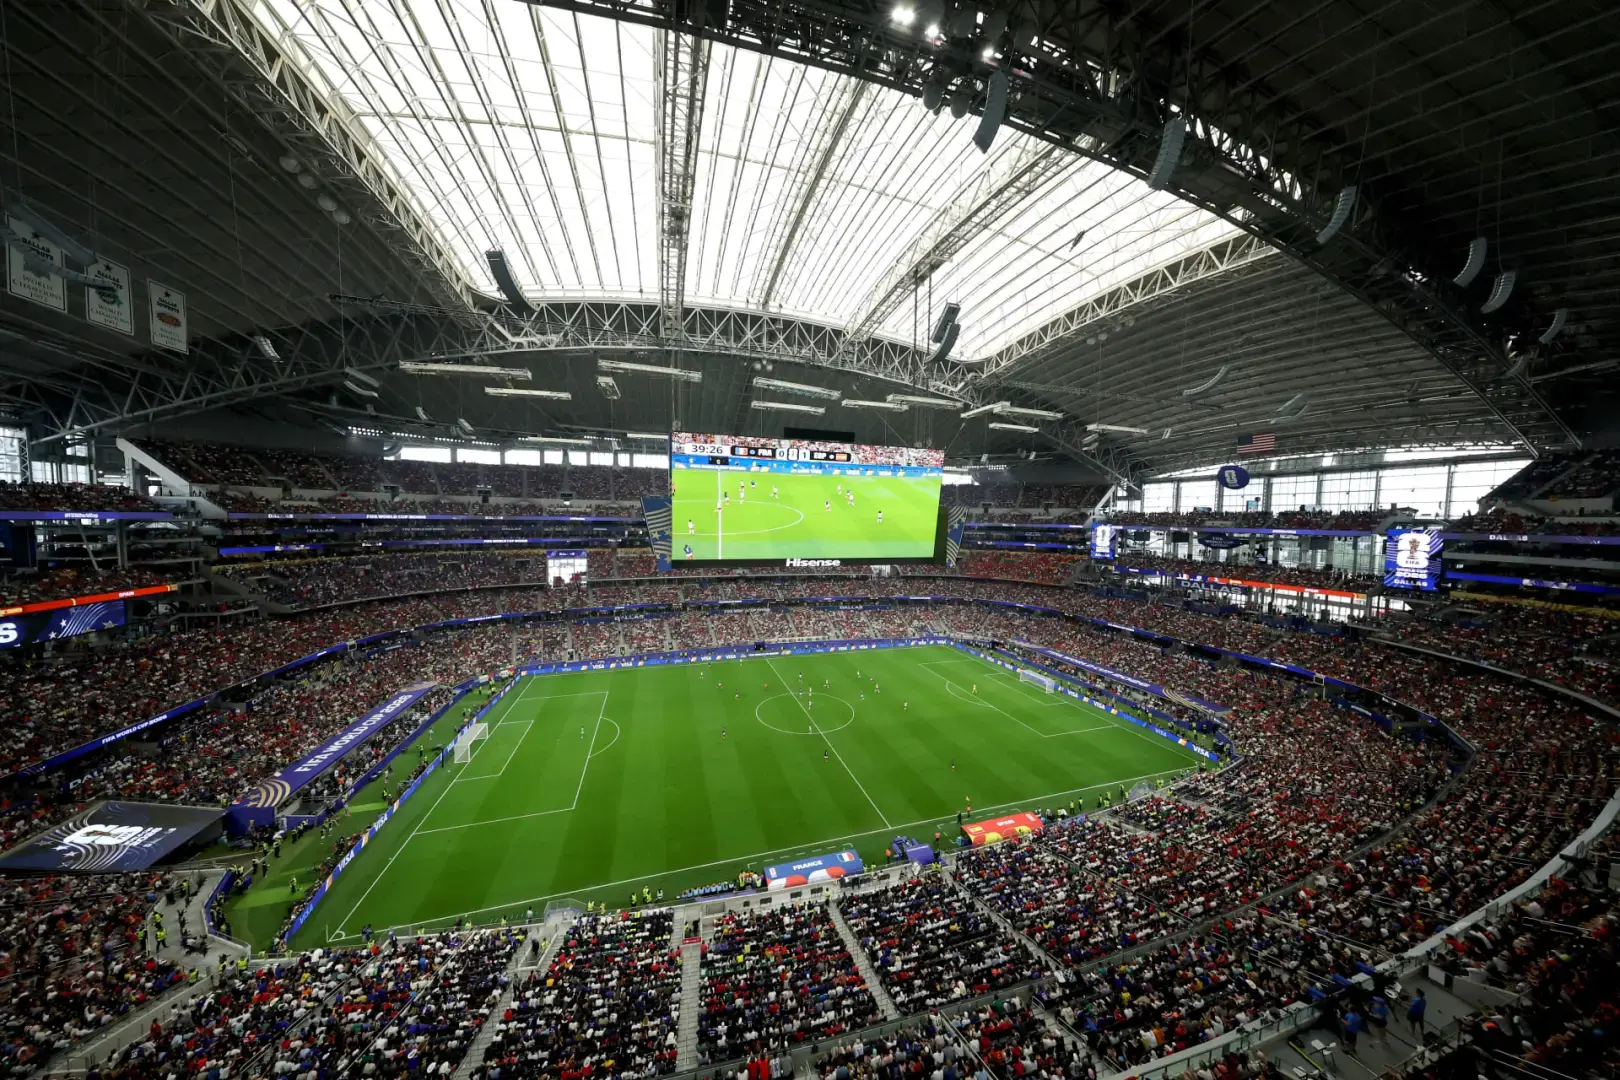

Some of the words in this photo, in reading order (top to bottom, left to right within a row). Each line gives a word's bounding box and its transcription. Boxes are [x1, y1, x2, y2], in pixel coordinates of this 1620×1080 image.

[691, 444, 724, 455] 39:26
[757, 448, 774, 458] FRA
[778, 450, 785, 458] 0
[785, 558, 841, 567] Hisense
[1180, 580, 1243, 595] DALLAS
[101, 734, 116, 745] FIFA
[115, 726, 138, 741] WORLD
[293, 752, 333, 773] FIFA
[322, 726, 369, 754] WORLD
[362, 713, 385, 726] CUP
[379, 694, 413, 714] 2026
[1154, 727, 1168, 737] VISA
[1191, 743, 1210, 758] VISA
[338, 849, 355, 872] VISA
[792, 859, 823, 871] FRANCE
